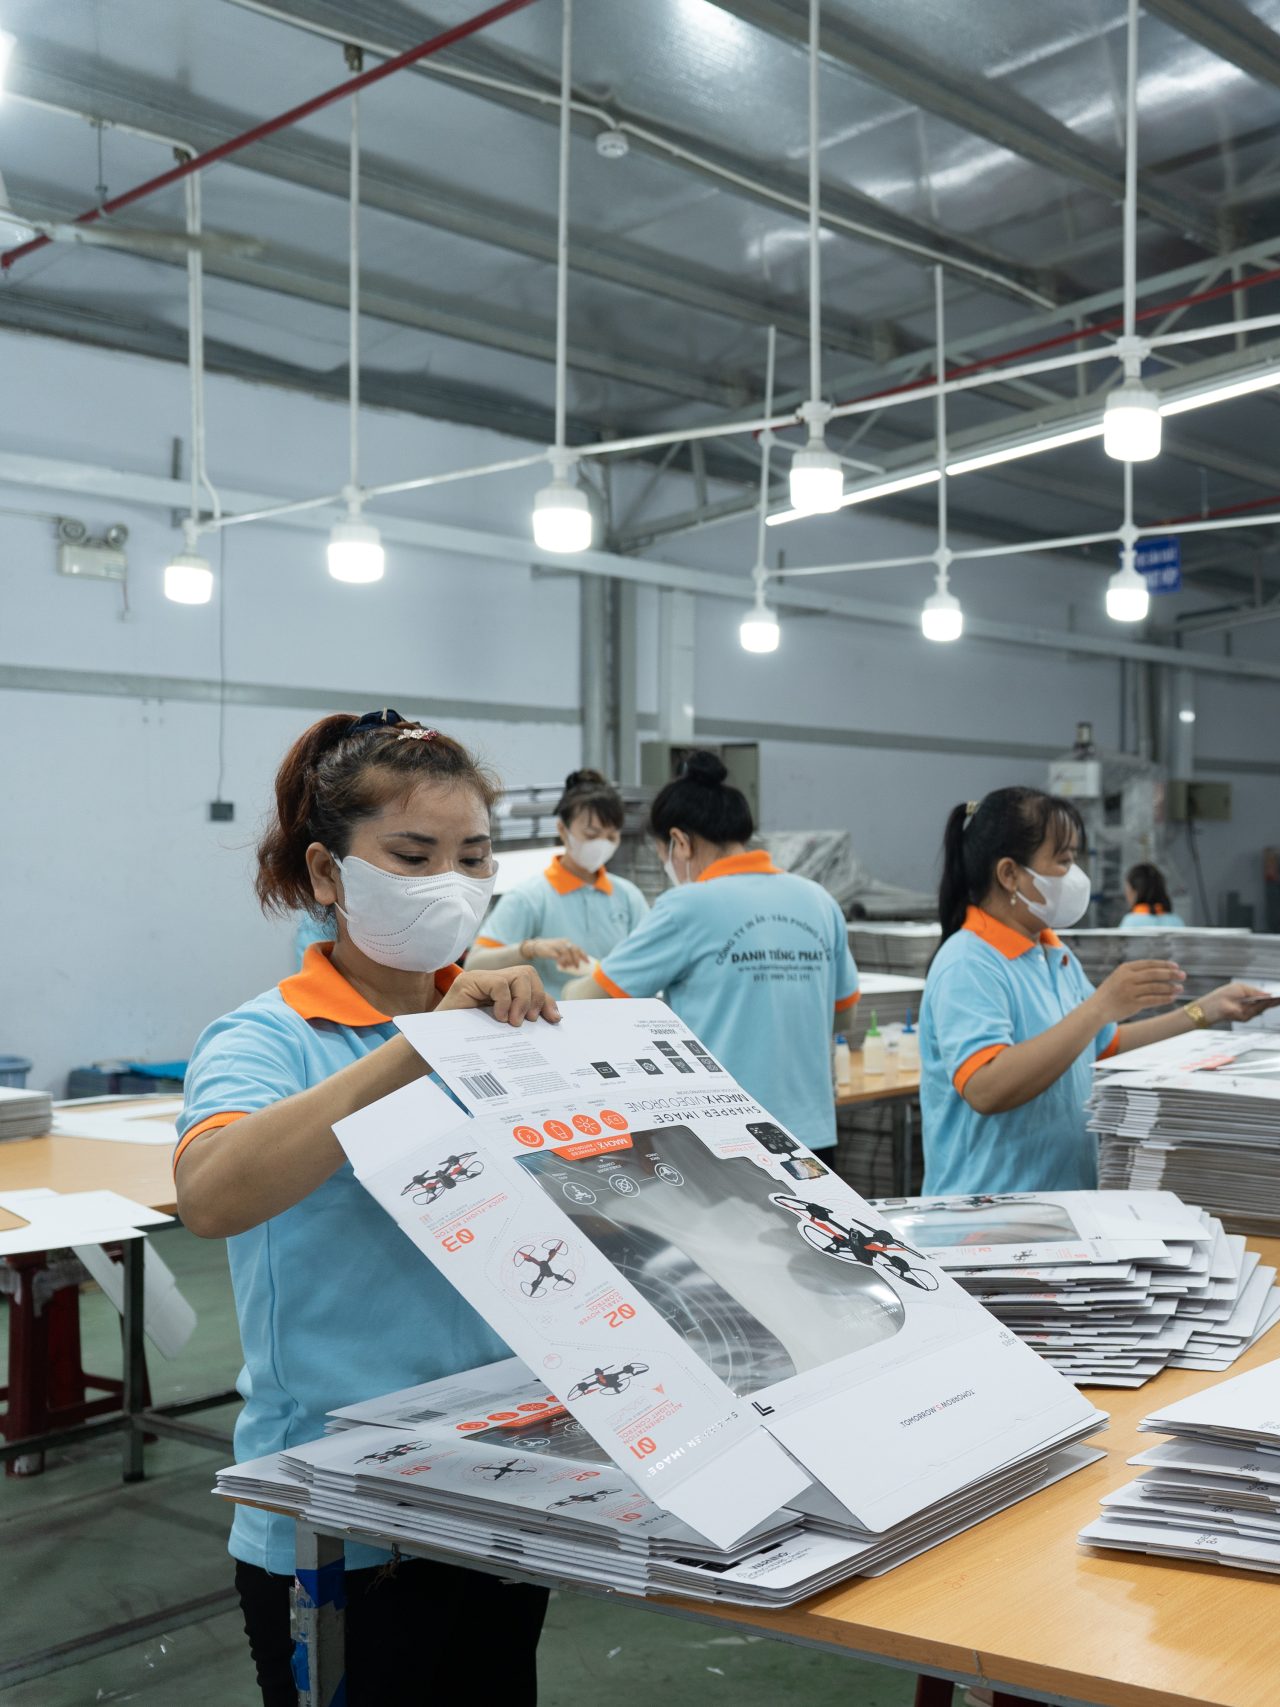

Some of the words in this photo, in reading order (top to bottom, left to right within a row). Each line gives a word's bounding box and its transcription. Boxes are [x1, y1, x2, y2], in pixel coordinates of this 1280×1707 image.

[731, 950, 766, 964] DANH
[769, 947, 796, 961] TIẾNG
[624, 1098, 668, 1112] DRONE
[668, 1096, 702, 1107] VIDEO
[702, 1095, 714, 1105] X
[715, 1093, 749, 1105] MACH
[703, 1104, 762, 1119] SHARPER
[604, 1138, 628, 1149] MACH
[441, 1228, 475, 1253] 03
[587, 1291, 620, 1312] CONTROL
[603, 1303, 637, 1329] 02
[665, 1403, 683, 1416] AUTO
[619, 1417, 651, 1439] CONTROL
[629, 1436, 657, 1461] 01
[647, 1446, 686, 1478] IMAGE
[399, 1465, 432, 1477] 03
[569, 1472, 601, 1482] 02
